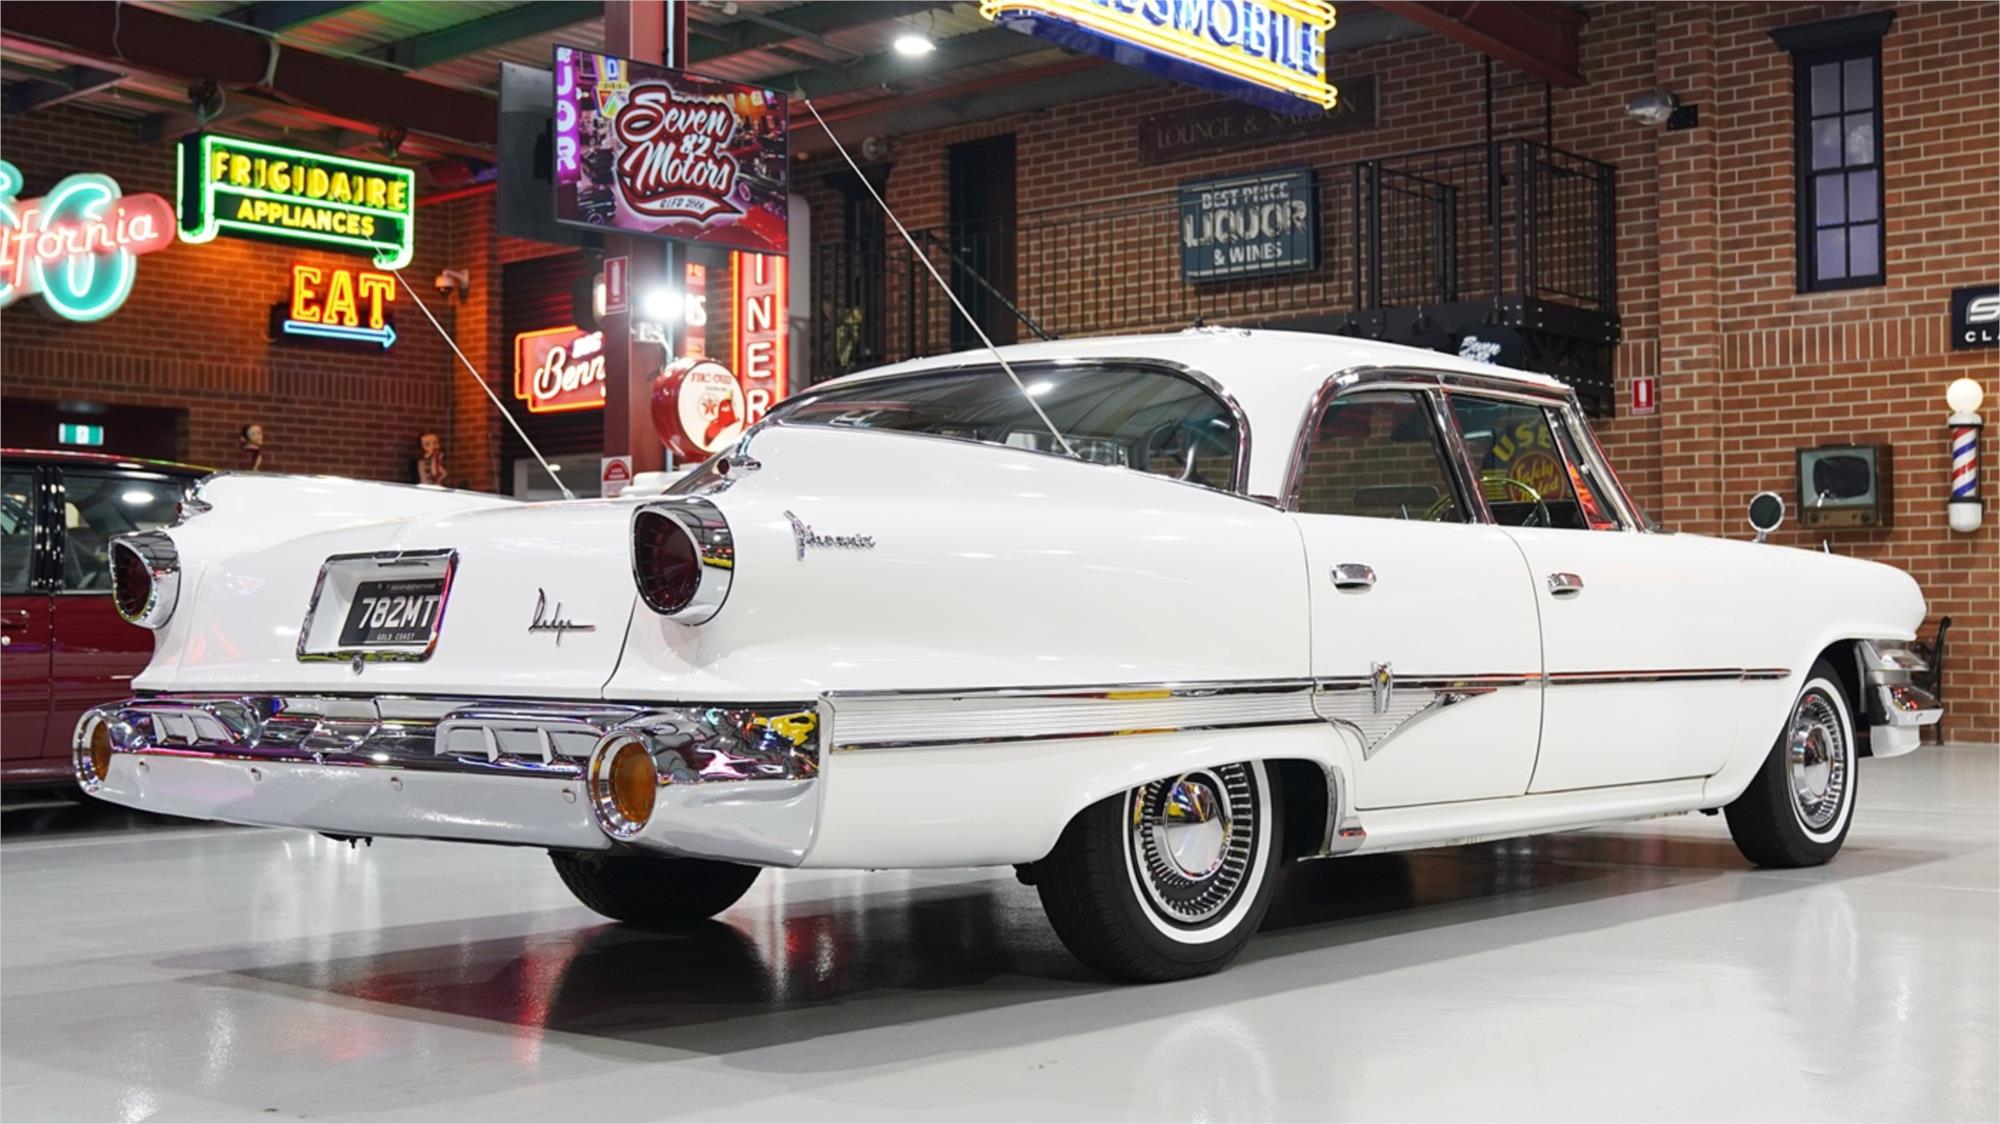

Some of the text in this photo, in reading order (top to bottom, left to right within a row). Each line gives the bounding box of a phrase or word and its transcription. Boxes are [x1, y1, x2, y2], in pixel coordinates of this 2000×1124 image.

[1093, 0, 1326, 76] SMOBILE
[621, 92, 728, 142] Seven
[1157, 115, 1235, 149] LOUNGE
[1243, 114, 1259, 134] &
[623, 141, 731, 192] Motors
[679, 134, 712, 158] 82
[213, 150, 408, 211] FRIGIDAIRE
[1202, 182, 1289, 210] BEST PRICE
[237, 198, 375, 238] APPLIANCES
[1183, 199, 1307, 248] LIQUOR
[1214, 241, 1282, 266] & WINES
[292, 265, 396, 330] EAT
